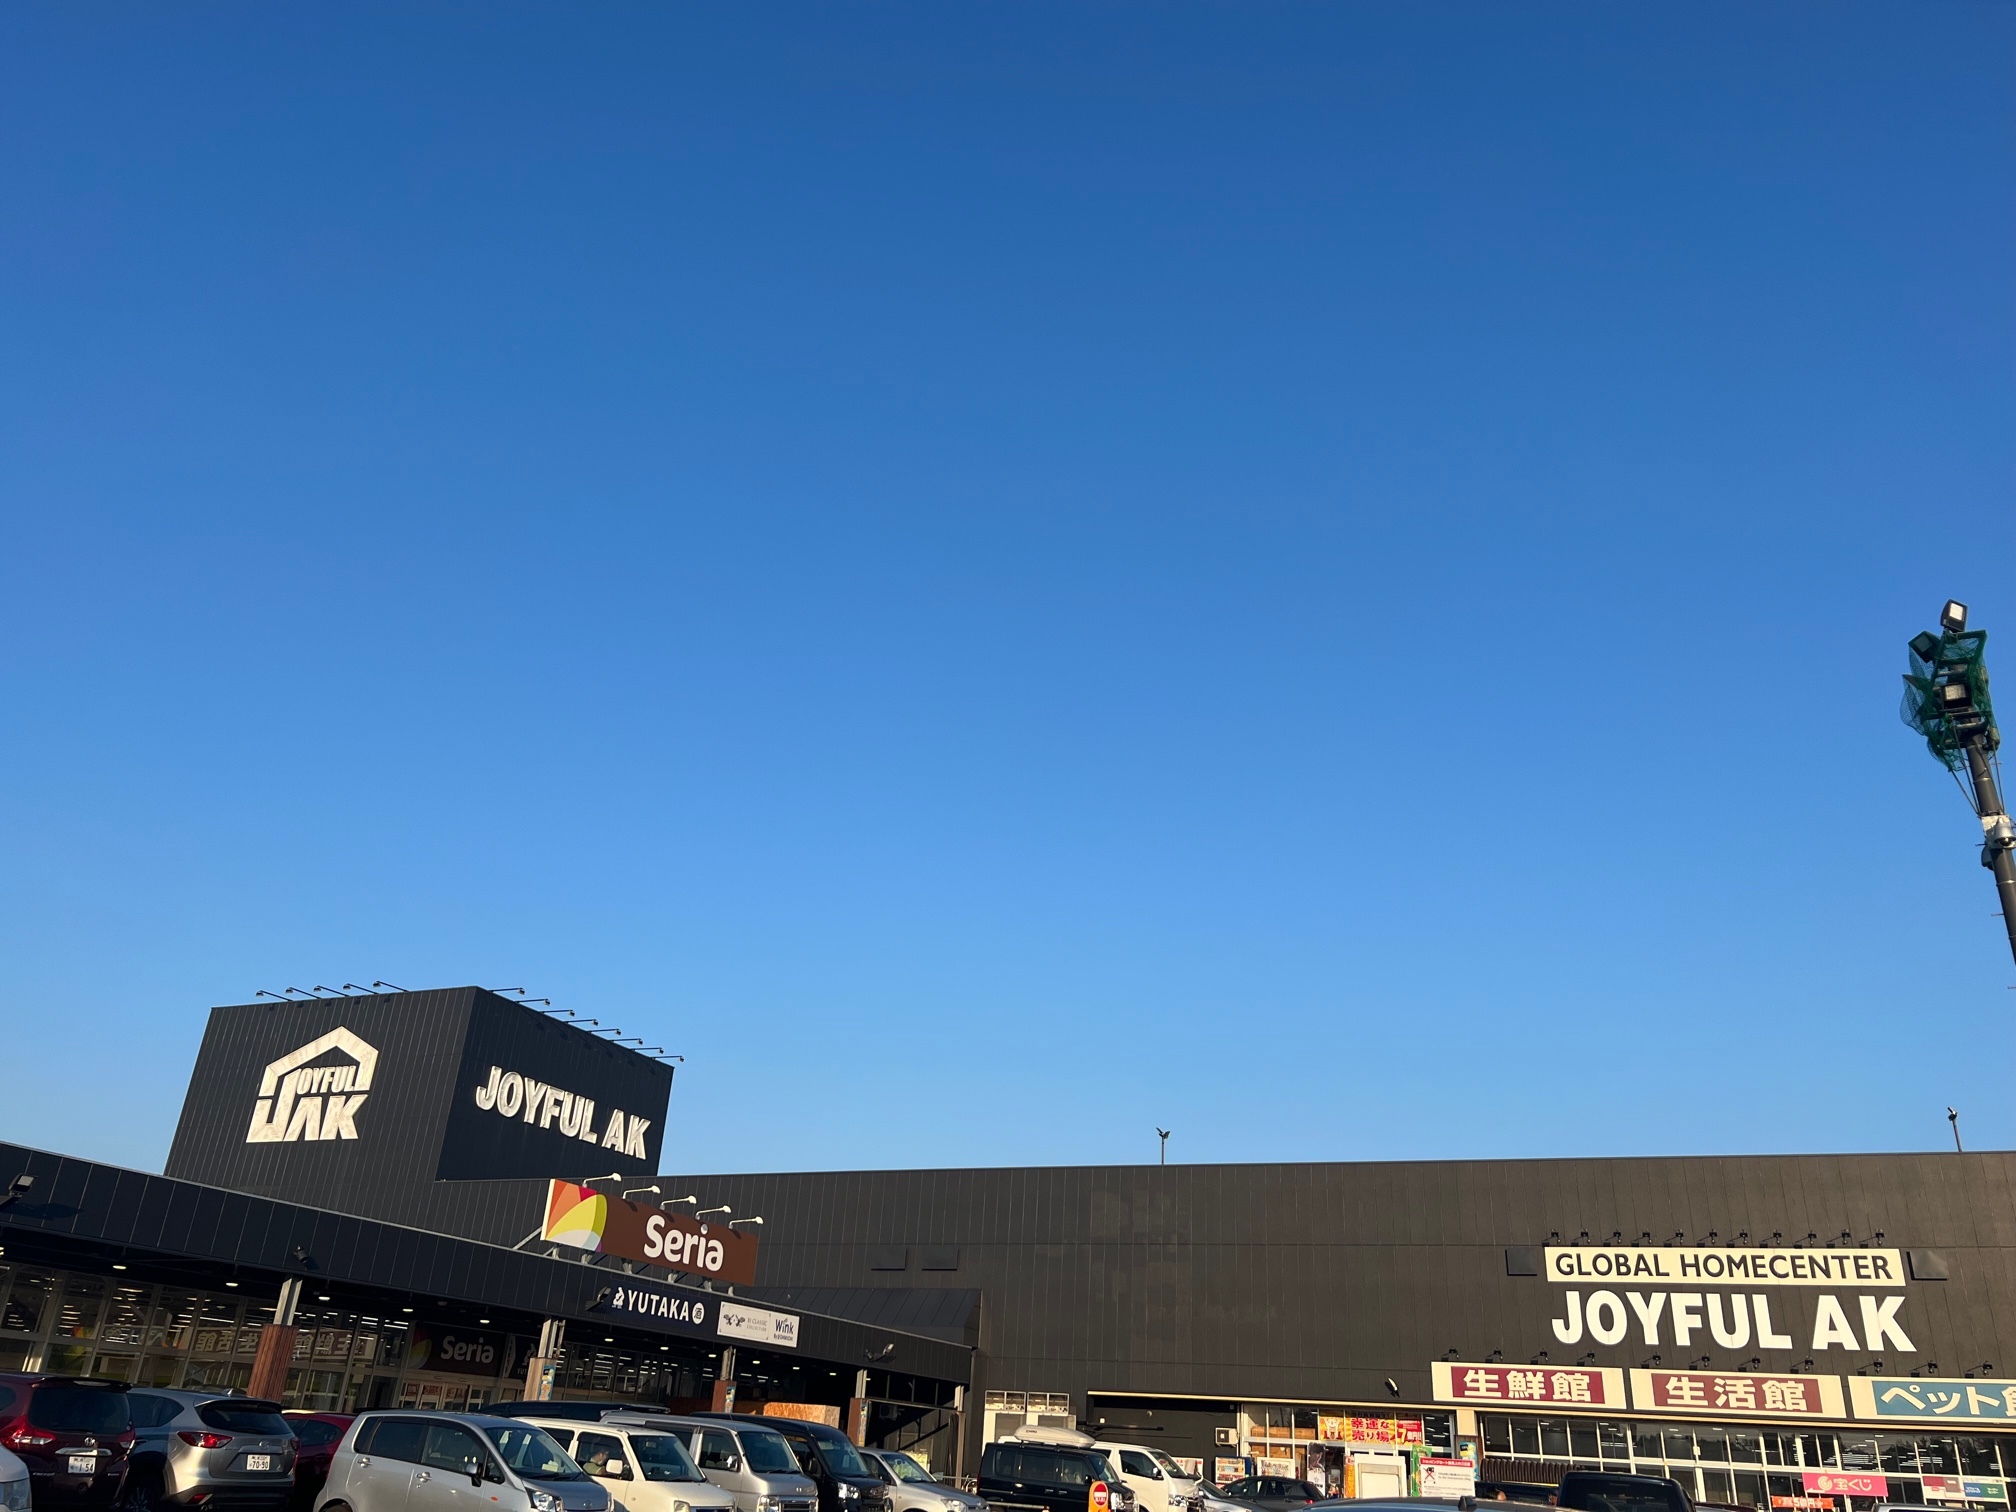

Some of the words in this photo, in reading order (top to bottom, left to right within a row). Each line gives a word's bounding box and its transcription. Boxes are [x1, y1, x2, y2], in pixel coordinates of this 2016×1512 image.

[475, 1065, 598, 1144] JOYFUL
[601, 1108, 651, 1160] AK
[643, 1214, 724, 1271] Seria
[1555, 1252, 1670, 1277] GLOBAL
[1680, 1253, 1893, 1280] HOMECENTER
[627, 1289, 690, 1322] YUTAKA
[1551, 1289, 1794, 1350] JOYFUL
[1811, 1294, 1918, 1353] AK
[775, 1318, 794, 1335] Wink
[440, 1335, 494, 1364] Seria
[1462, 1369, 1592, 1402] 生鮮館
[1665, 1376, 1806, 1412] 生活館
[1351, 1418, 1389, 1431] 幸運な
[1351, 1429, 1389, 1443] 売り場
[1834, 1478, 1872, 1491] 宝くじ
